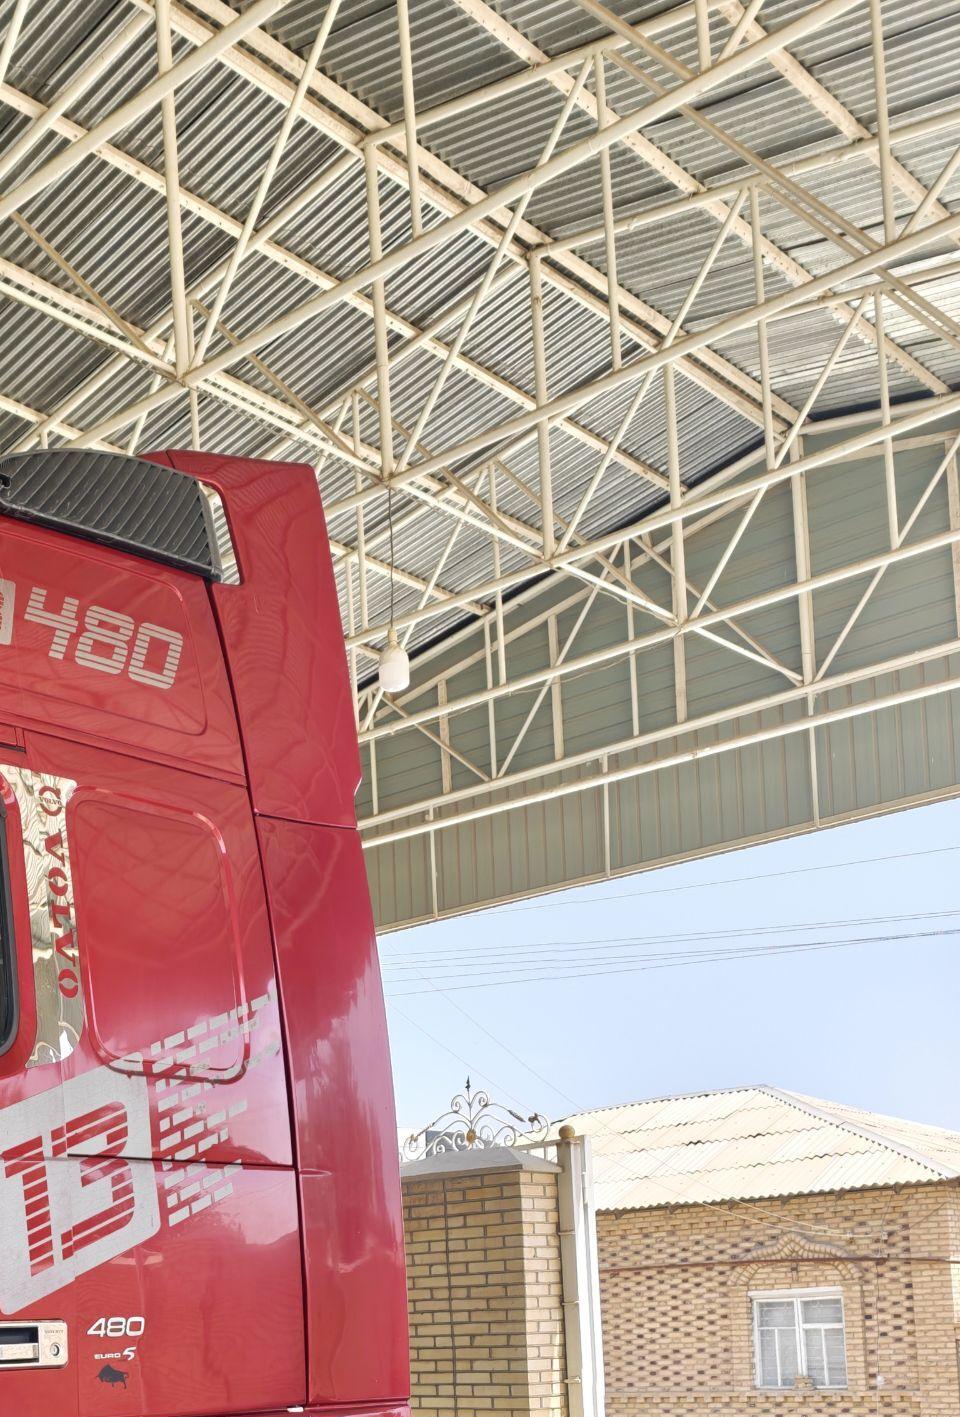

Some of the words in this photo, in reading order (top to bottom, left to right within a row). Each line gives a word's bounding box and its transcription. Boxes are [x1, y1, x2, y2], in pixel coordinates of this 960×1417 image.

[23, 586, 183, 690] 480
[44, 828, 79, 999] VOLVO
[86, 1316, 146, 1338] 480
[94, 1352, 122, 1360] EURO
